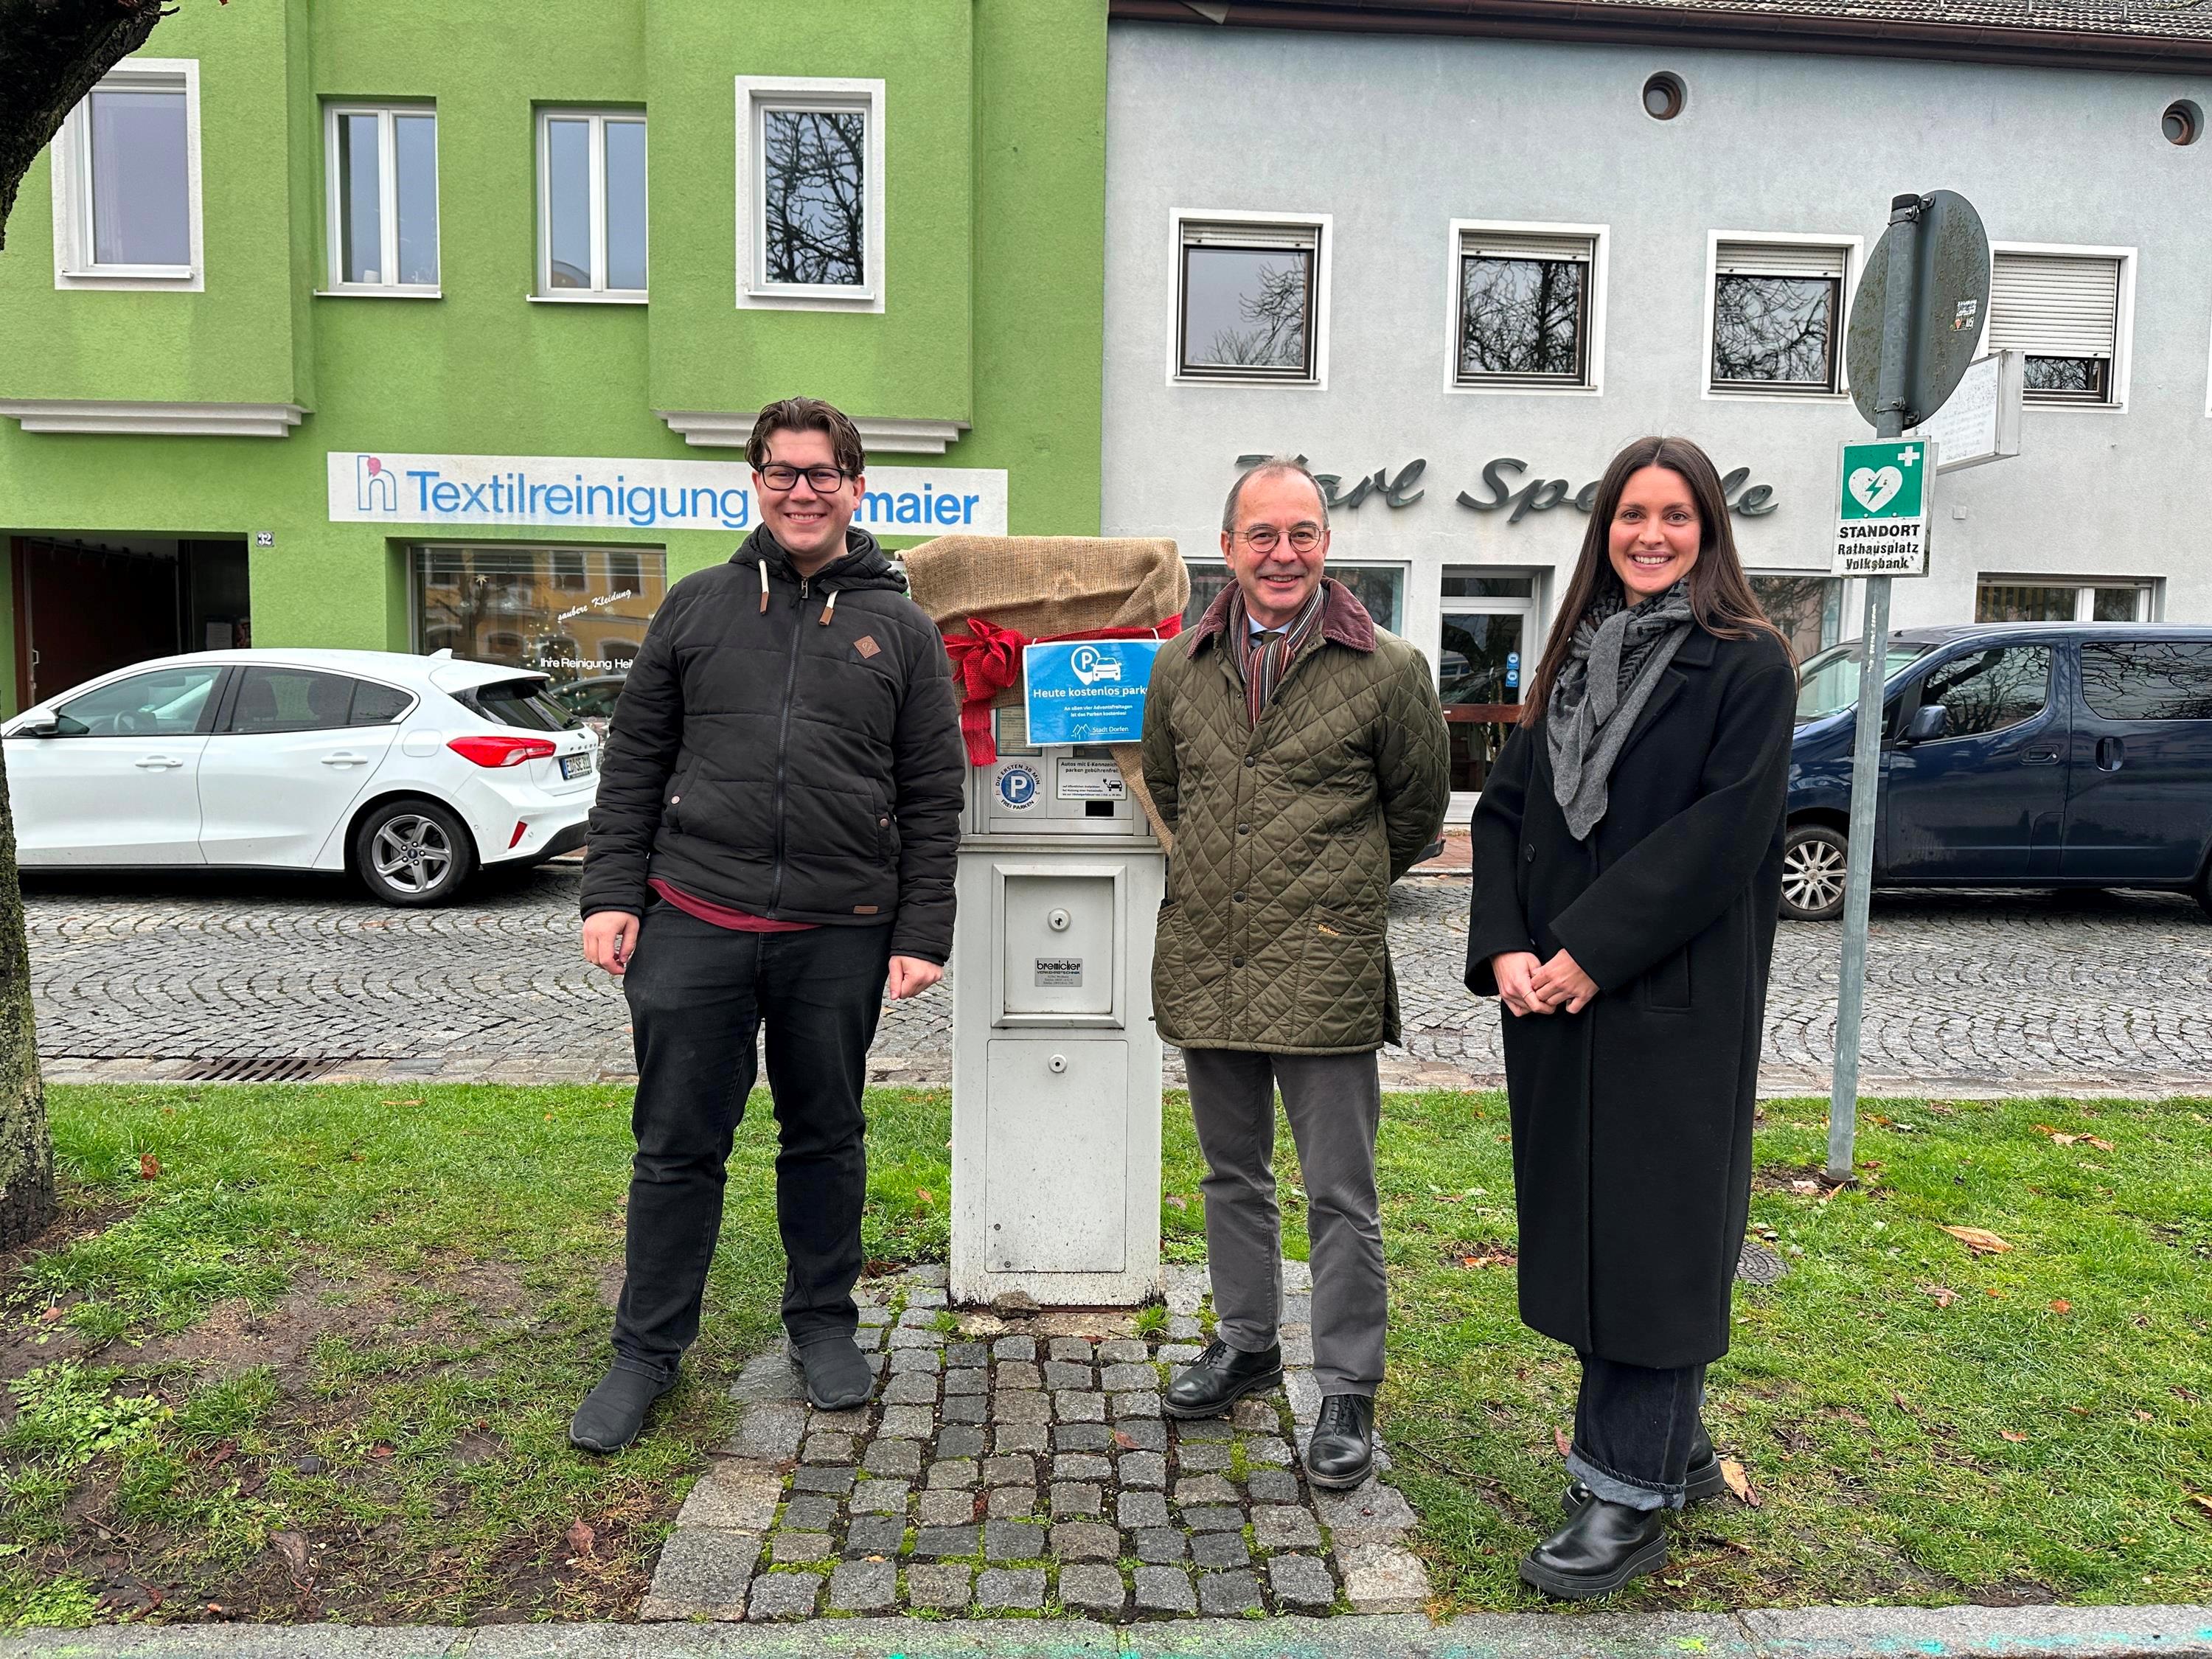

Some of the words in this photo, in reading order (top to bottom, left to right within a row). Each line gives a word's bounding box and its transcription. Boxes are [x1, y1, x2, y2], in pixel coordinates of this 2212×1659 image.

[1235, 453, 1427, 509] arl
[406, 470, 748, 529] Textilreinigung
[854, 483, 979, 525] maier
[1840, 524, 1920, 538] STANDORT
[258, 533, 271, 546] 32
[1837, 542, 1919, 555] Rathausplatz
[1846, 557, 1910, 570] Volksbank
[557, 605, 588, 621] saubere
[591, 589, 632, 608] Kleidung
[540, 658, 560, 668] Ihre
[561, 658, 612, 670] Reinigung
[615, 658, 633, 669] Heil
[1033, 688, 1066, 698] Heute
[1068, 686, 1120, 698] kostenlos
[1122, 685, 1148, 698] park
[1001, 764, 1023, 775] ERSTEN
[1032, 772, 1040, 785] MIN
[1011, 776, 1027, 798] P
[1001, 799, 1012, 809] FREI
[1012, 800, 1034, 810] PARKEN
[1318, 924, 1340, 936] Barbour
[1037, 960, 1080, 970] bremicker
